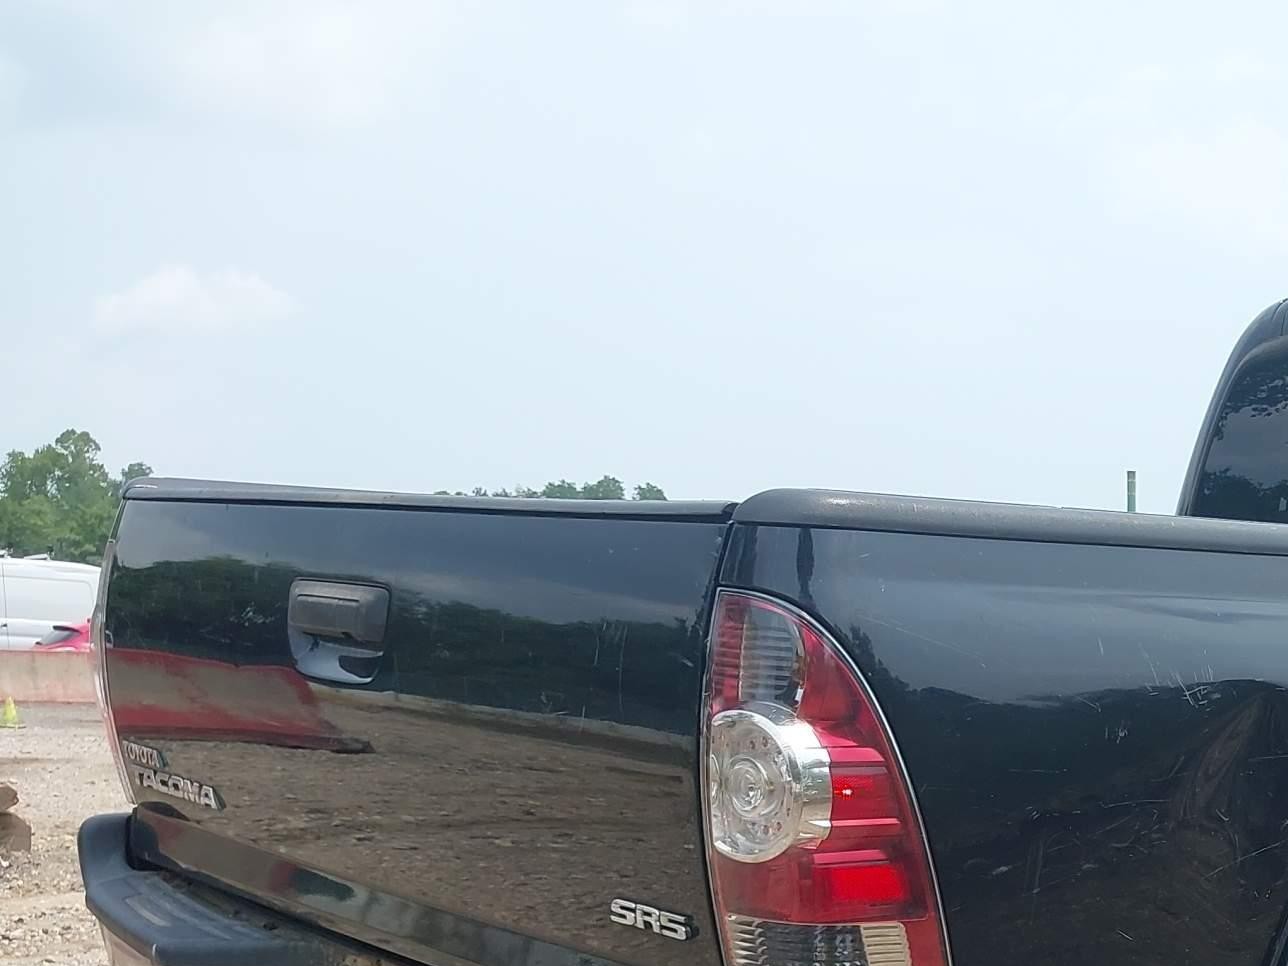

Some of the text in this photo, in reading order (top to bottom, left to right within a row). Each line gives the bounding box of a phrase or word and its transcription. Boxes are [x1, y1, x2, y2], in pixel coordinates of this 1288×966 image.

[122, 740, 161, 769] TOYOTA
[131, 764, 218, 810] TACOMA
[610, 898, 688, 941] SR5
